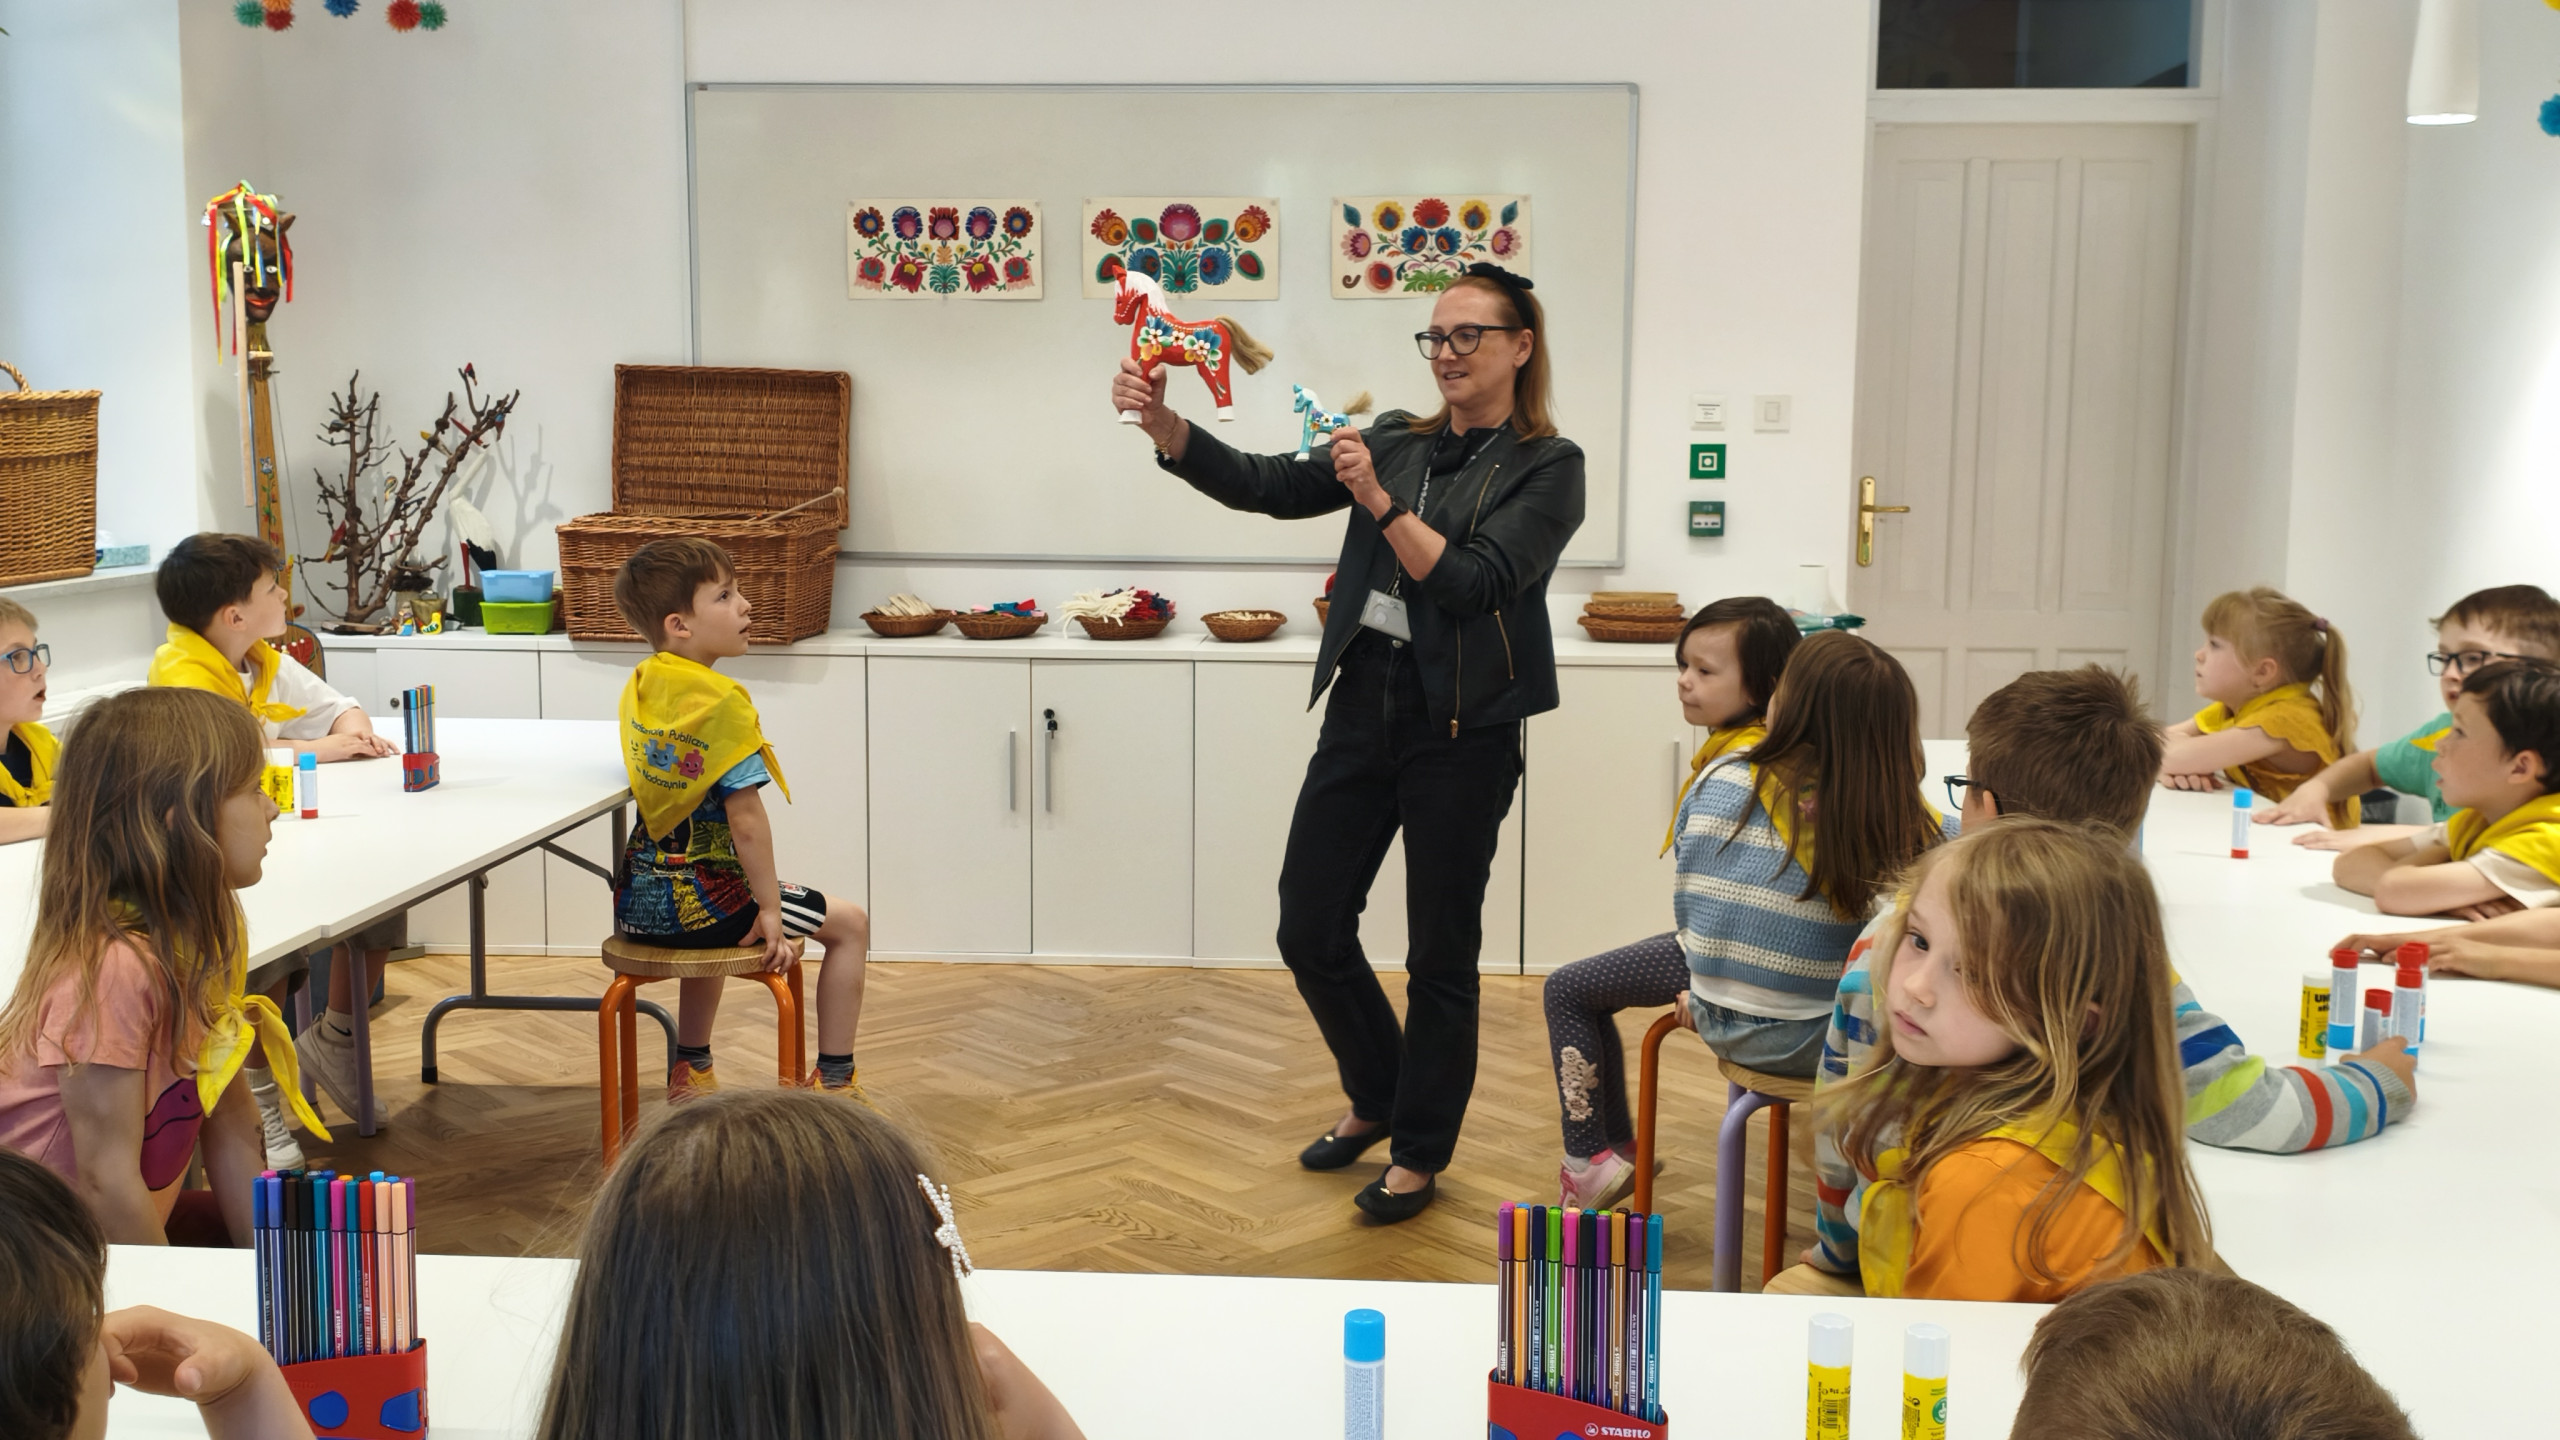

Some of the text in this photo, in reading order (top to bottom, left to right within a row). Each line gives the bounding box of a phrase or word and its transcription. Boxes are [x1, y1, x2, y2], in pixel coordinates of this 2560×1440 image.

[668, 729, 710, 751] Publiczne
[642, 769, 688, 791] Nadarzynie
[1600, 1426, 1651, 1439] STABILO
